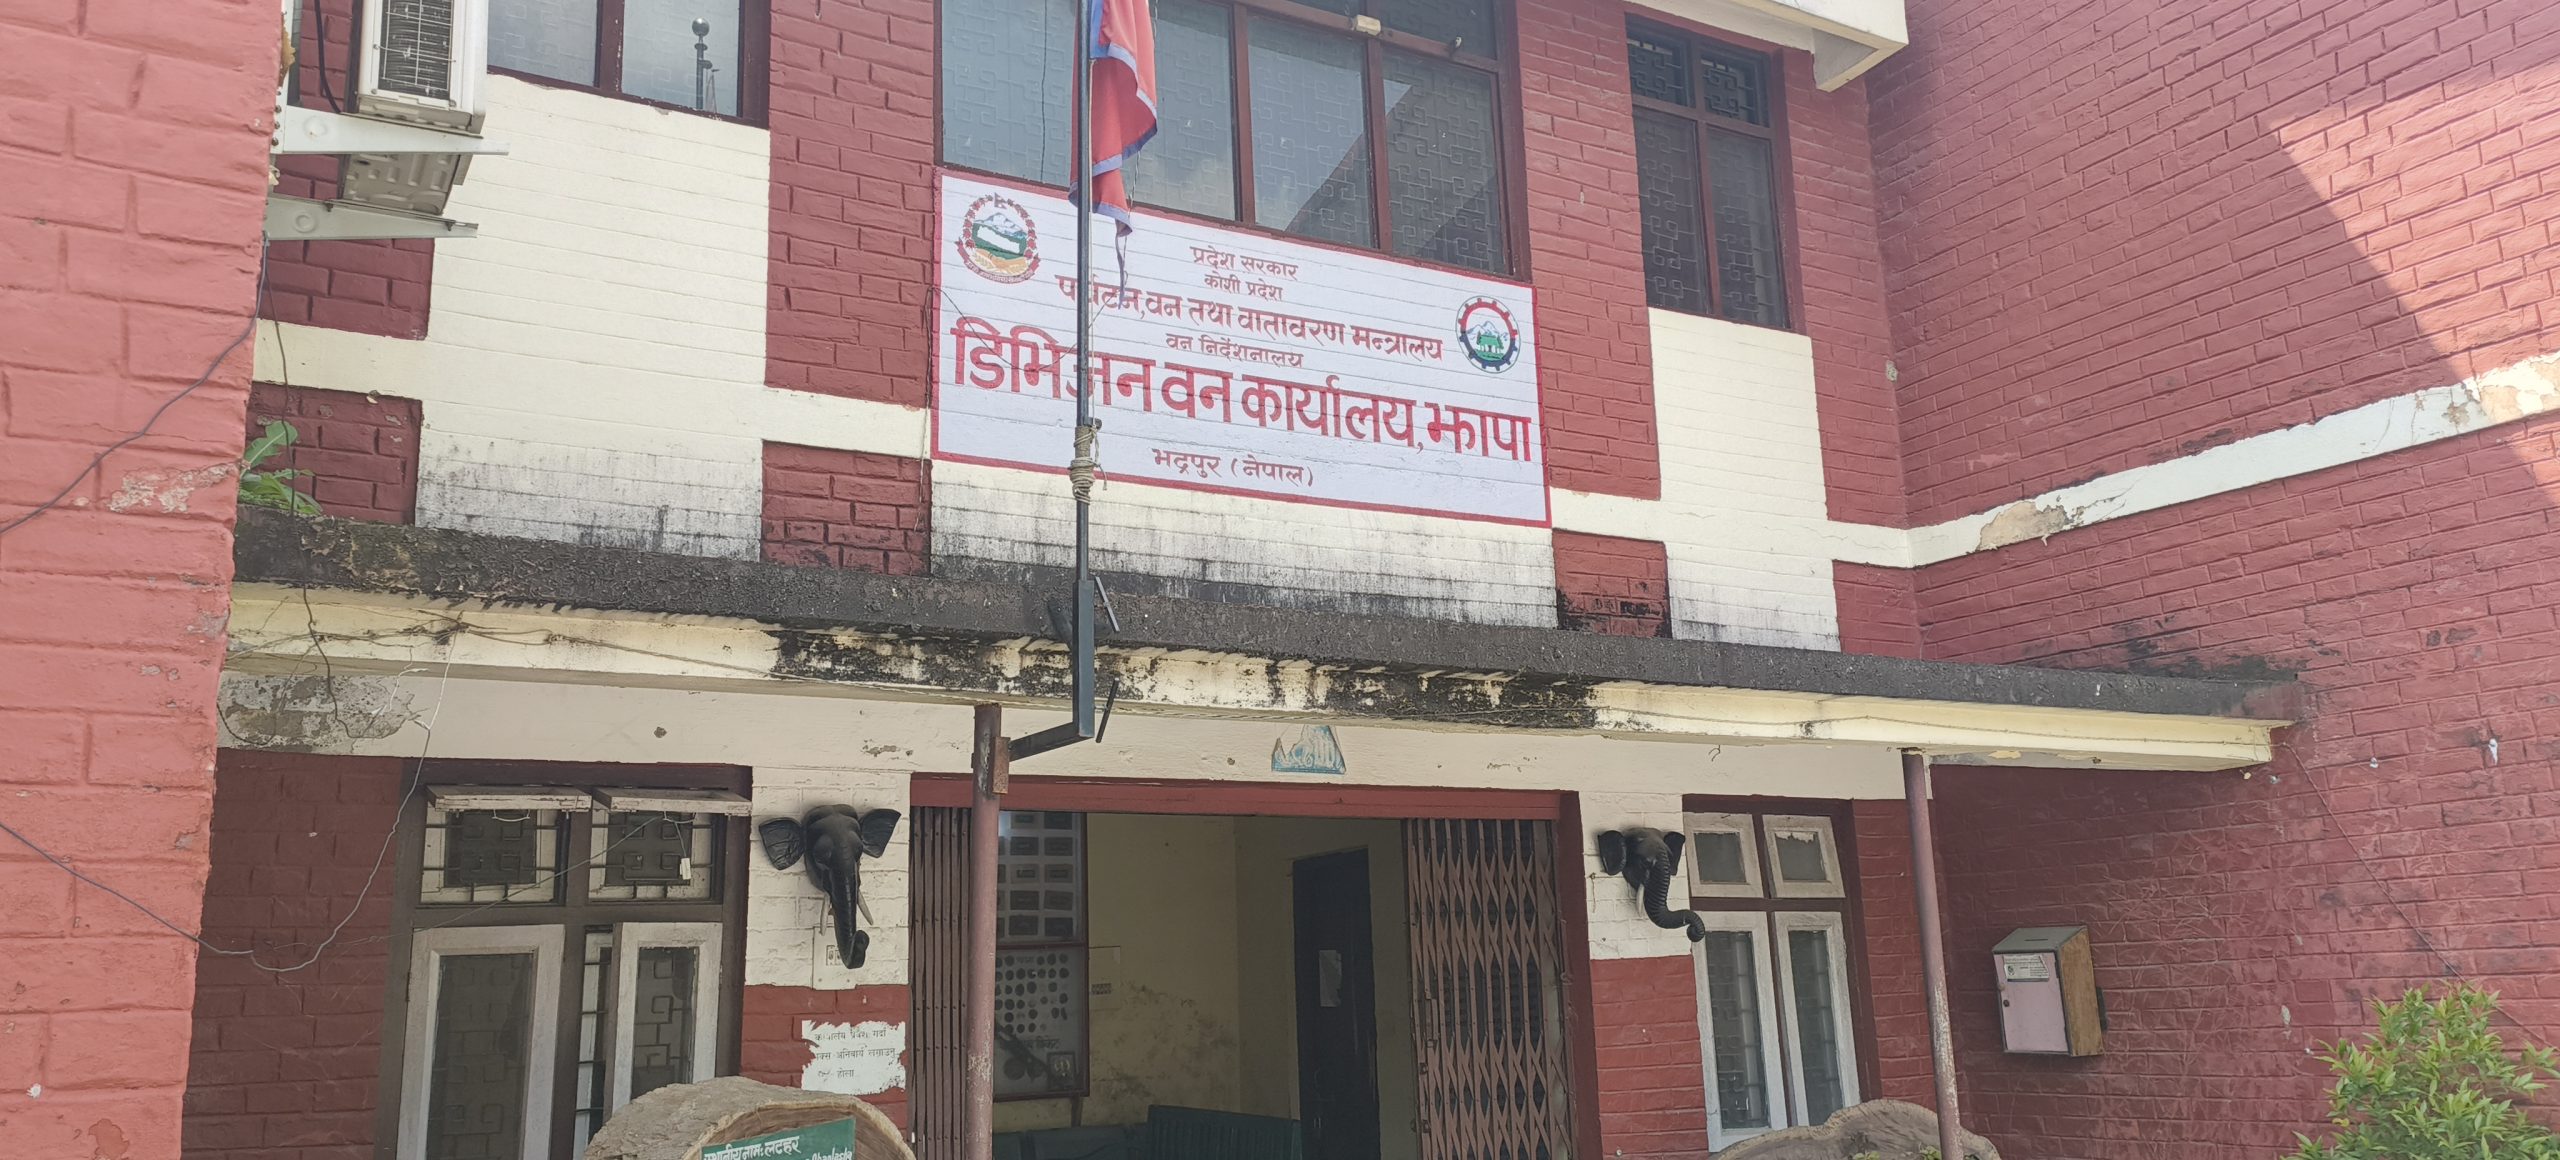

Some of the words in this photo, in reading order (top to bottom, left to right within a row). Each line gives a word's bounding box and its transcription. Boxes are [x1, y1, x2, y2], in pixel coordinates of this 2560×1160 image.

[1189, 245, 1236, 270] प्रदेश
[1240, 254, 1298, 281] सरकार
[1204, 270, 1241, 295] कोशी
[1245, 278, 1283, 301] प्रदेश
[1166, 333, 1193, 352] वन
[1187, 297, 1232, 328] तथा
[1238, 306, 1346, 346] वातावरण
[1350, 325, 1444, 361] मन्त्रालय
[950, 316, 1156, 413] डिभिजन
[1161, 361, 1234, 423] वन
[1152, 448, 1222, 479] भद्रपुर
